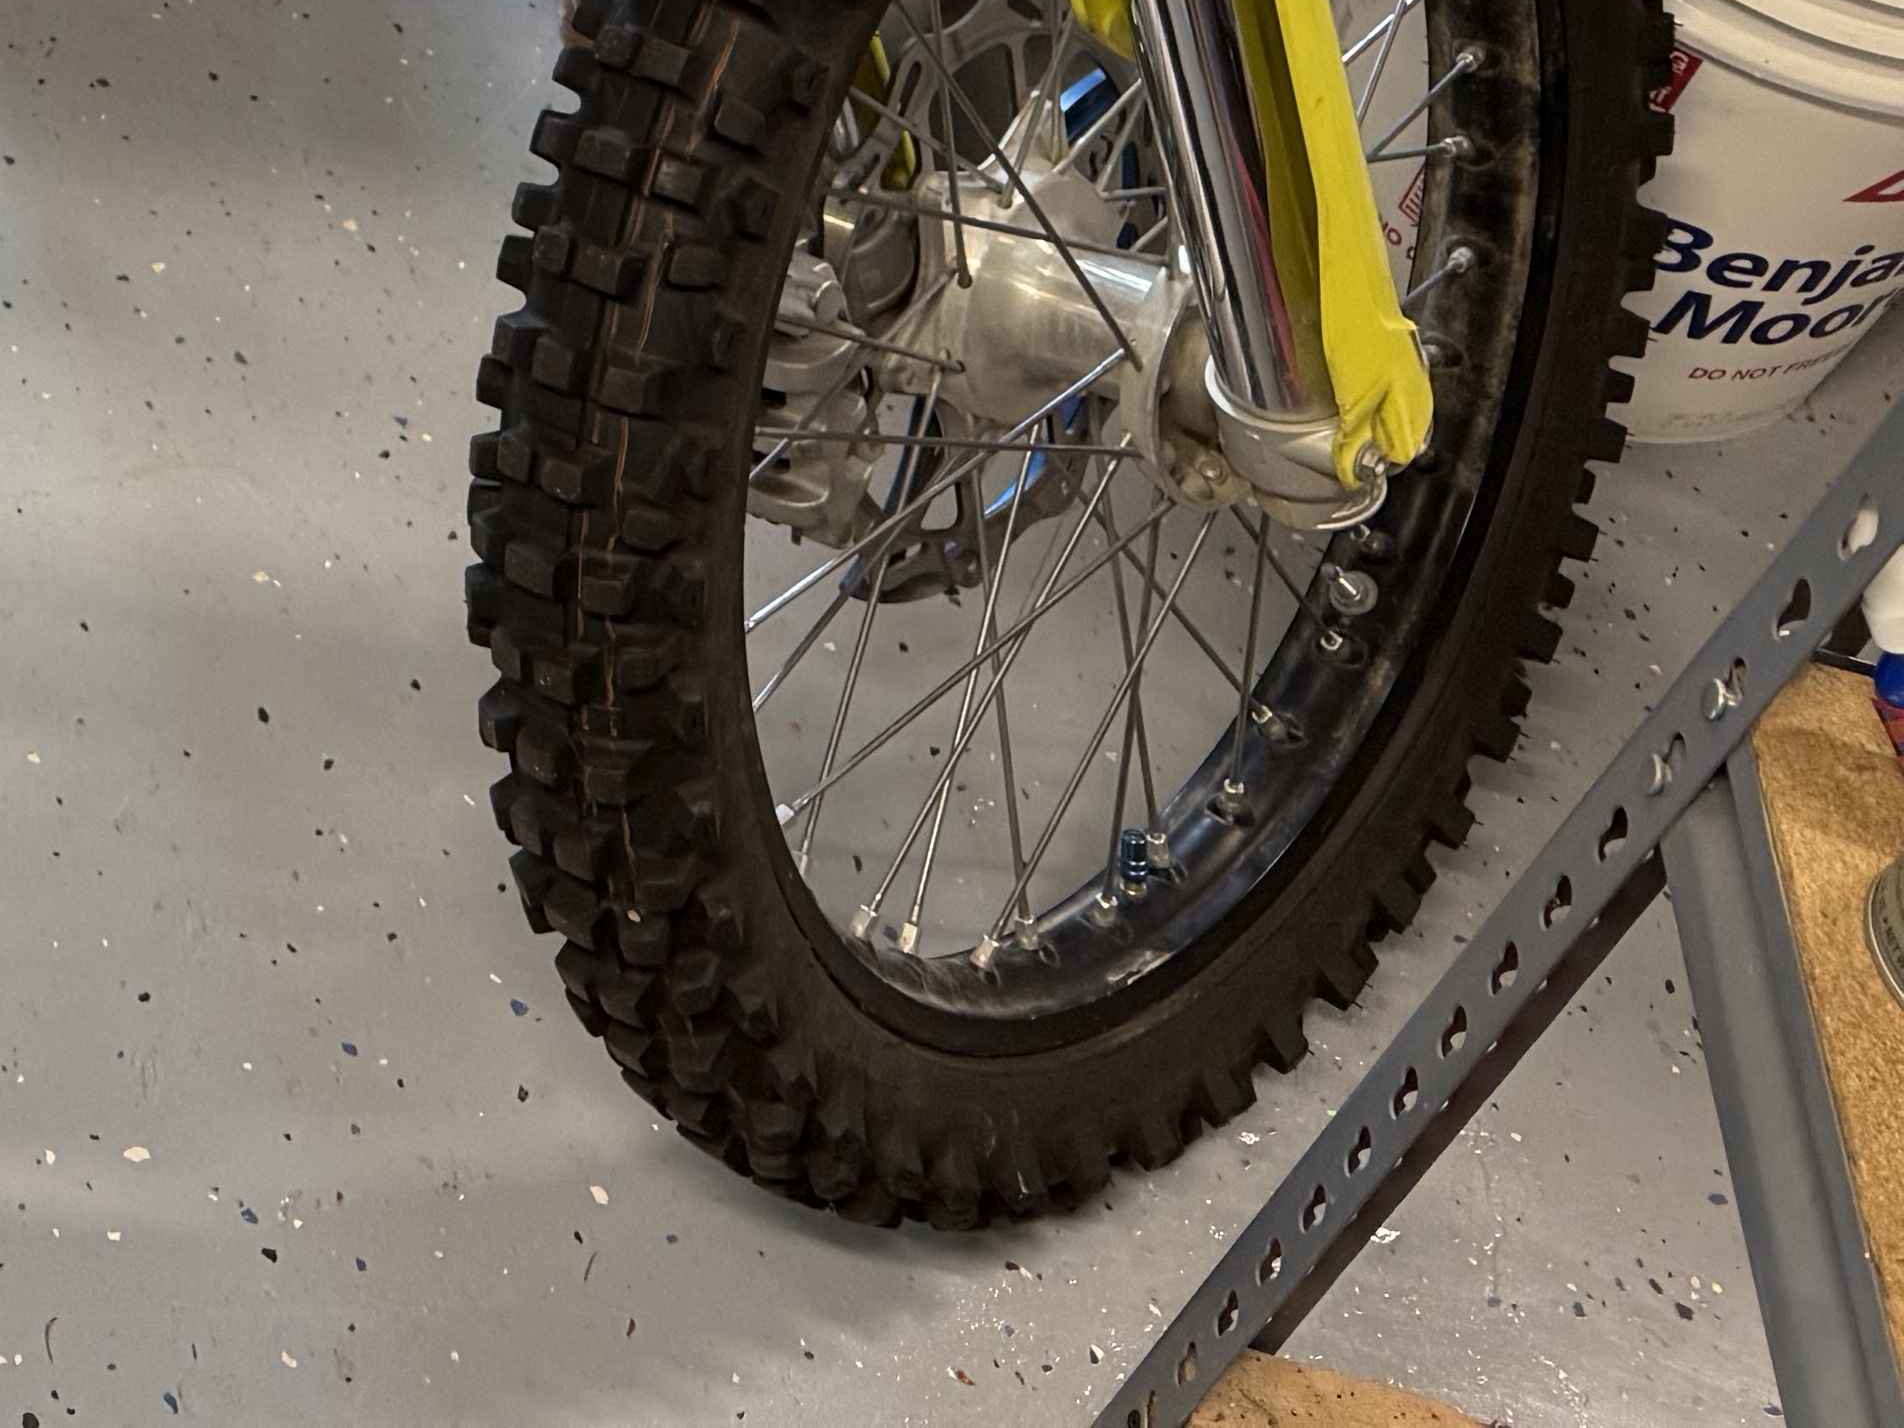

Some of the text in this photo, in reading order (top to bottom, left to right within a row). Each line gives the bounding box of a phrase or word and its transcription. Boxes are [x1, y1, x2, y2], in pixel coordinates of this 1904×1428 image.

[1656, 217, 1904, 306] Benja
[1688, 366, 1727, 381] DO
[1731, 364, 1782, 381] NOT
